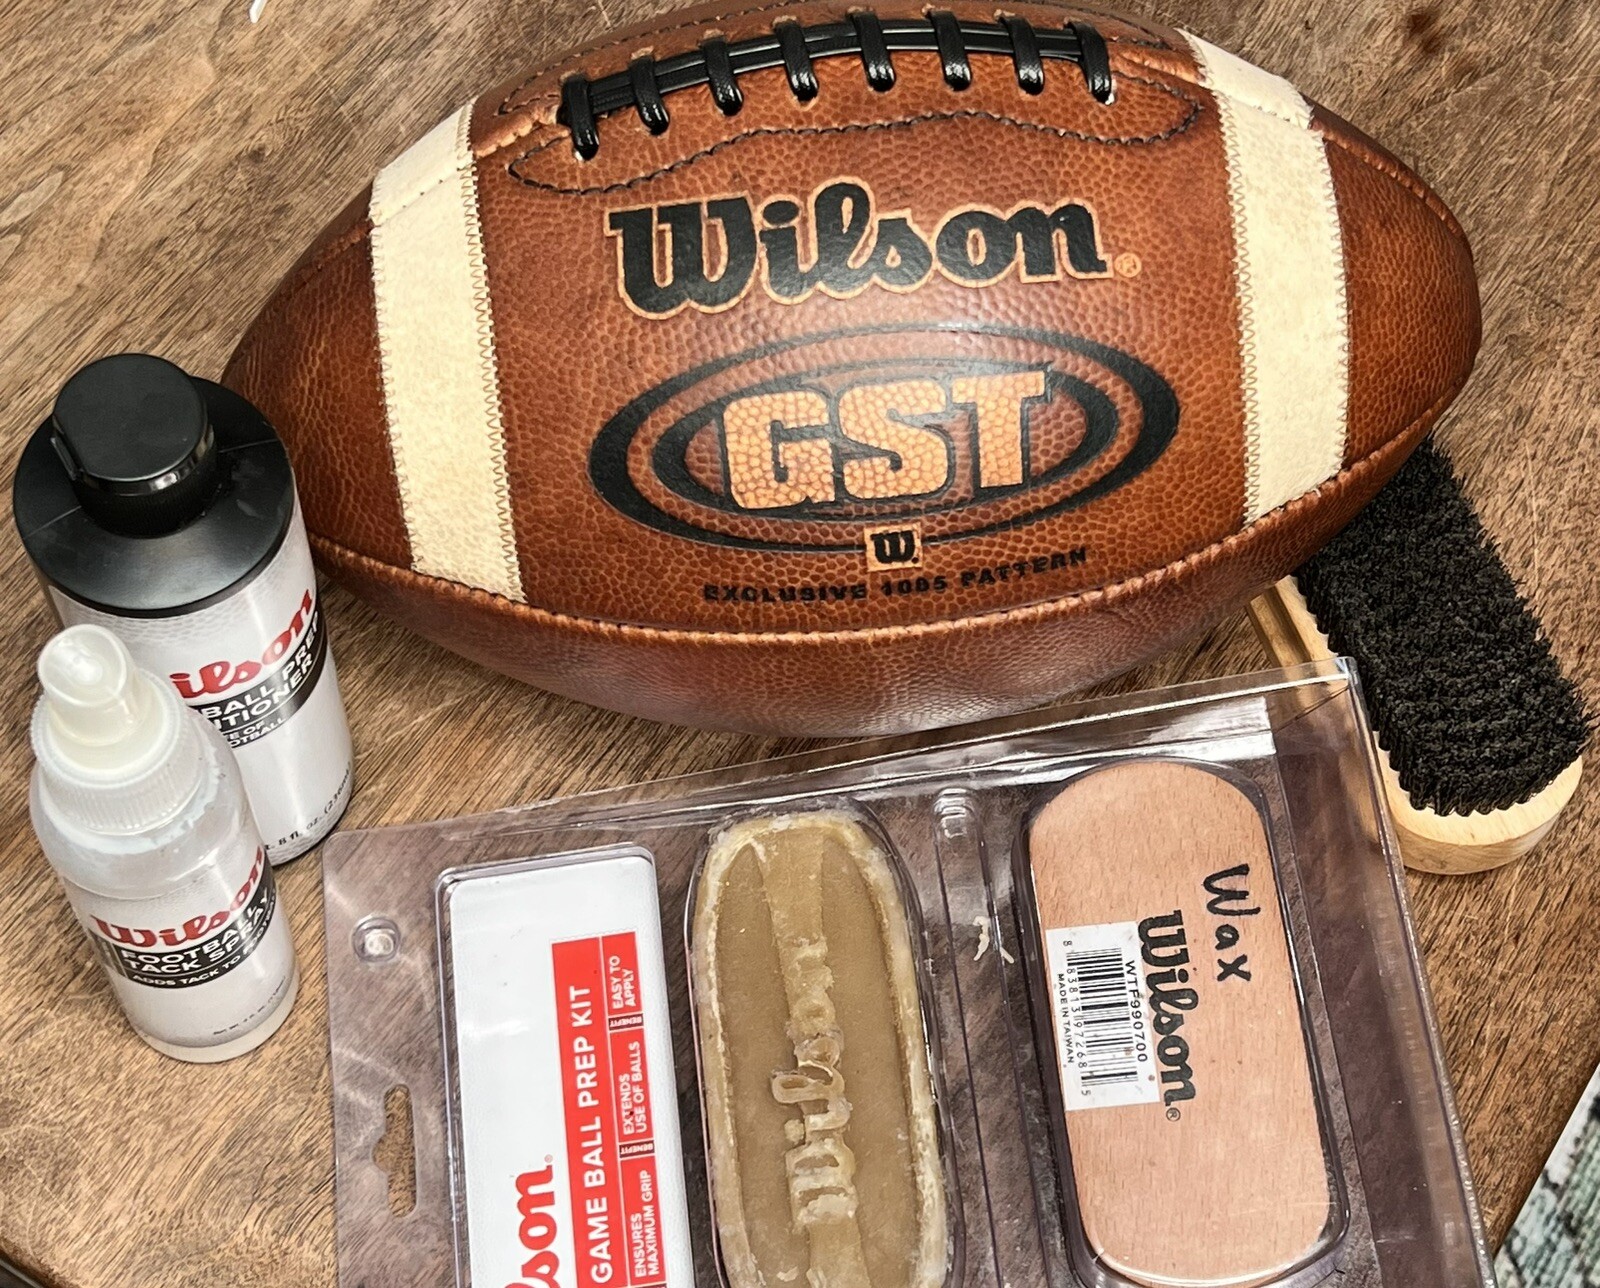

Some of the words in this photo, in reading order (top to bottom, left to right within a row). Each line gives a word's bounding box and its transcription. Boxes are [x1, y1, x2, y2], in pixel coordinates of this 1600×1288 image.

[604, 176, 1113, 320] Wilson
[722, 371, 1049, 510] GST
[704, 585, 867, 603] EXCLUSIVE
[880, 575, 947, 597] 1005
[960, 547, 1087, 588] PATTERN
[170, 589, 312, 698] ilson
[201, 687, 275, 718] BALL
[213, 653, 312, 730] ITIONER
[229, 717, 286, 747] OTBALL
[90, 845, 262, 948] Wilson
[1202, 863, 1261, 982] Wax
[120, 906, 257, 964] FOOTBALL
[124, 958, 202, 974] TACK
[208, 887, 268, 962] SPRAY
[132, 974, 177, 986] ADDS
[179, 968, 219, 984] TACK
[222, 955, 241, 969] TO
[608, 955, 621, 974] TO
[611, 977, 624, 1009] EASY
[622, 968, 637, 1007] APPLY
[1056, 973, 1067, 1004] MADE
[569, 985, 593, 1028] KIT
[1061, 1006, 1070, 1018] IN
[1124, 960, 1148, 1063] WTF990700
[1137, 909, 1199, 1106] Wilson
[573, 1036, 599, 1108] PREP
[628, 1041, 643, 1082] BALLS
[1064, 1020, 1075, 1064] TAIWAN
[619, 1073, 635, 1135] EXTENDS
[632, 1084, 645, 1104] OF
[635, 1106, 648, 1133] USE
[580, 1116, 606, 1188] BALL
[639, 1170, 653, 1202] GRIP
[503, 1164, 560, 1288] son
[585, 1197, 613, 1284] GAME
[630, 1213, 647, 1278] ENSURES
[642, 1205, 660, 1275] MAXIMUM
